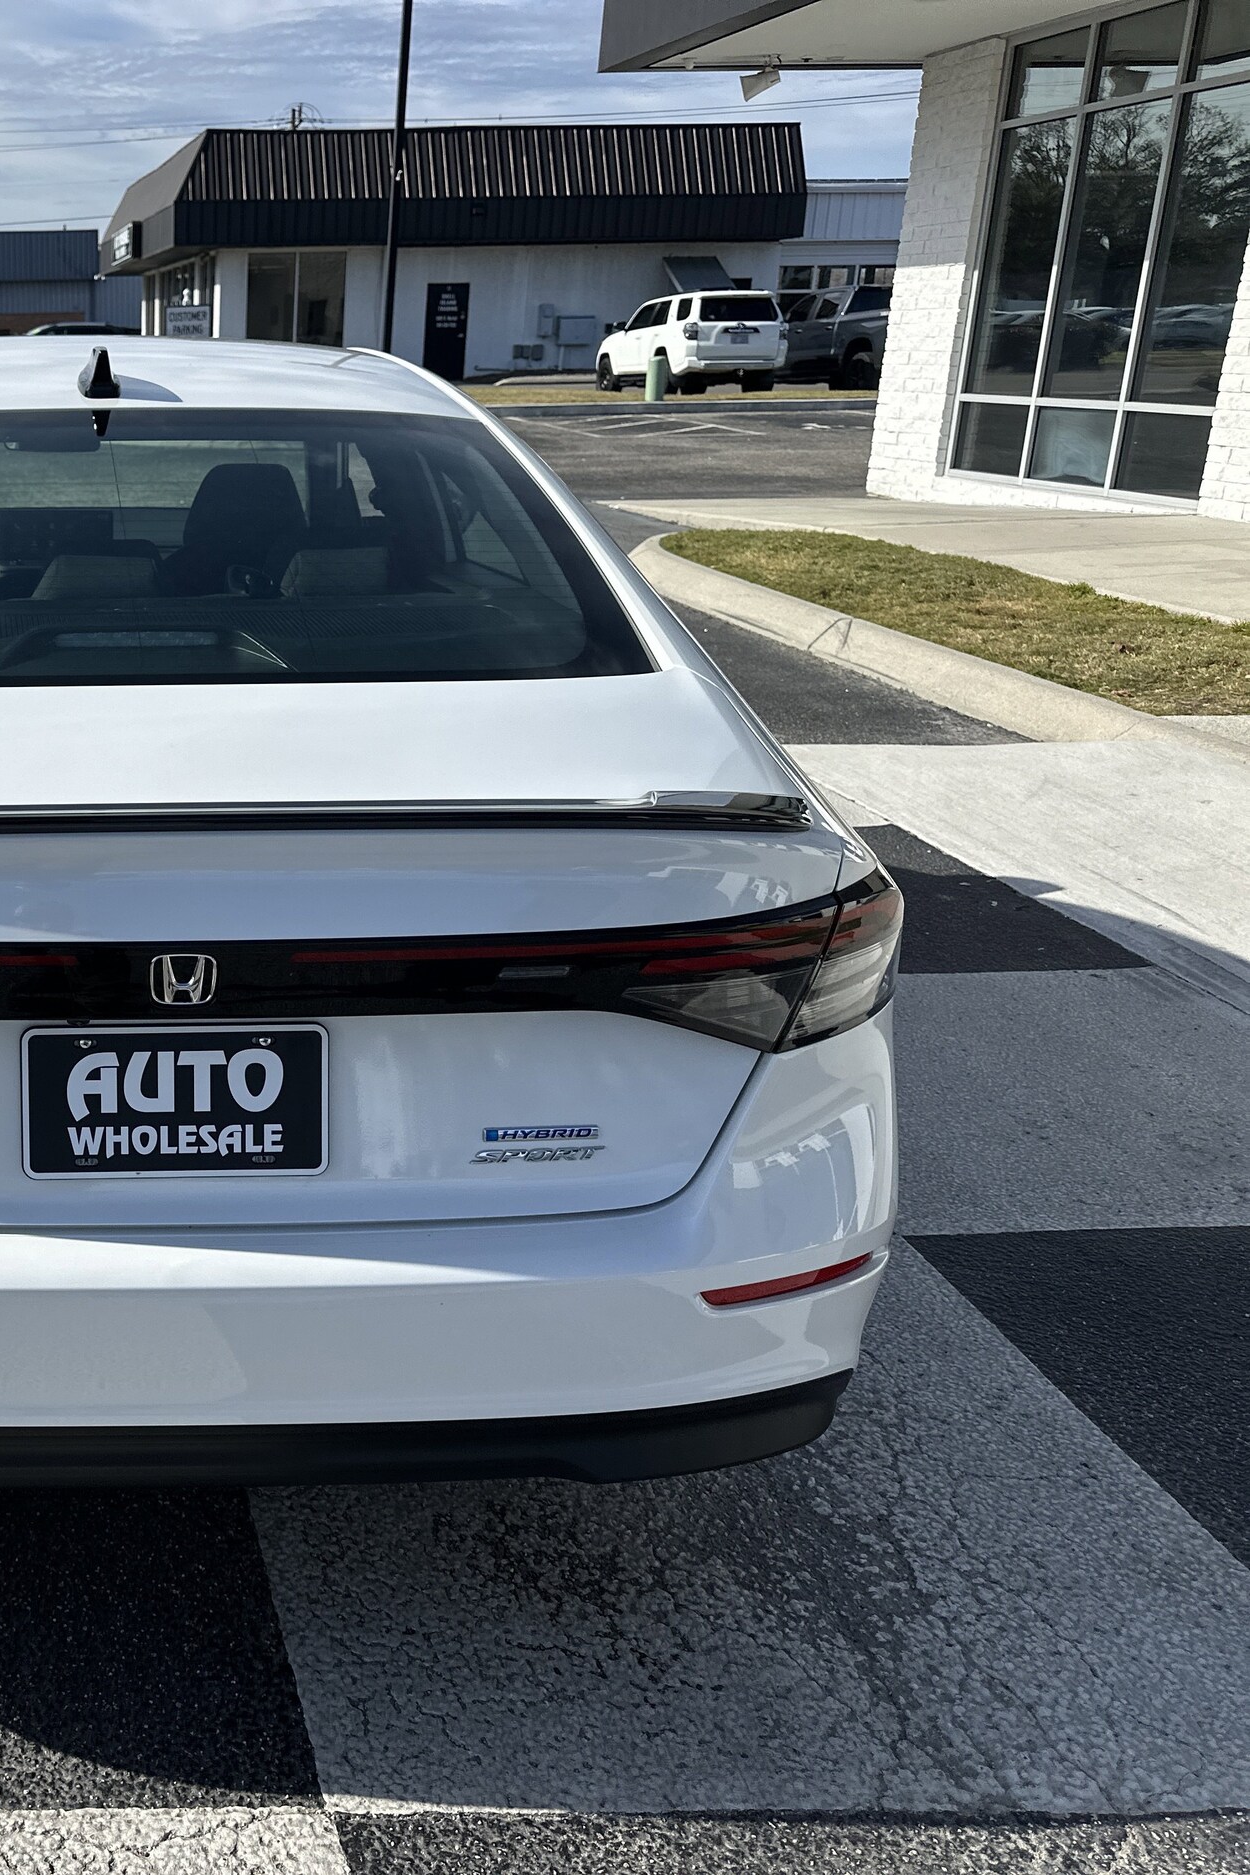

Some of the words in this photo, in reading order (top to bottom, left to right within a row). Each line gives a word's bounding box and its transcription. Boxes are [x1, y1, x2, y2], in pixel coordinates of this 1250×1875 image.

[169, 311, 207, 322] CUSTOMER
[172, 325, 204, 336] PARKING
[67, 1048, 284, 1122] AUTO
[67, 1123, 284, 1159] WHOLESALE
[501, 1128, 592, 1140] HYBRID
[469, 1145, 606, 1165] SPORT
